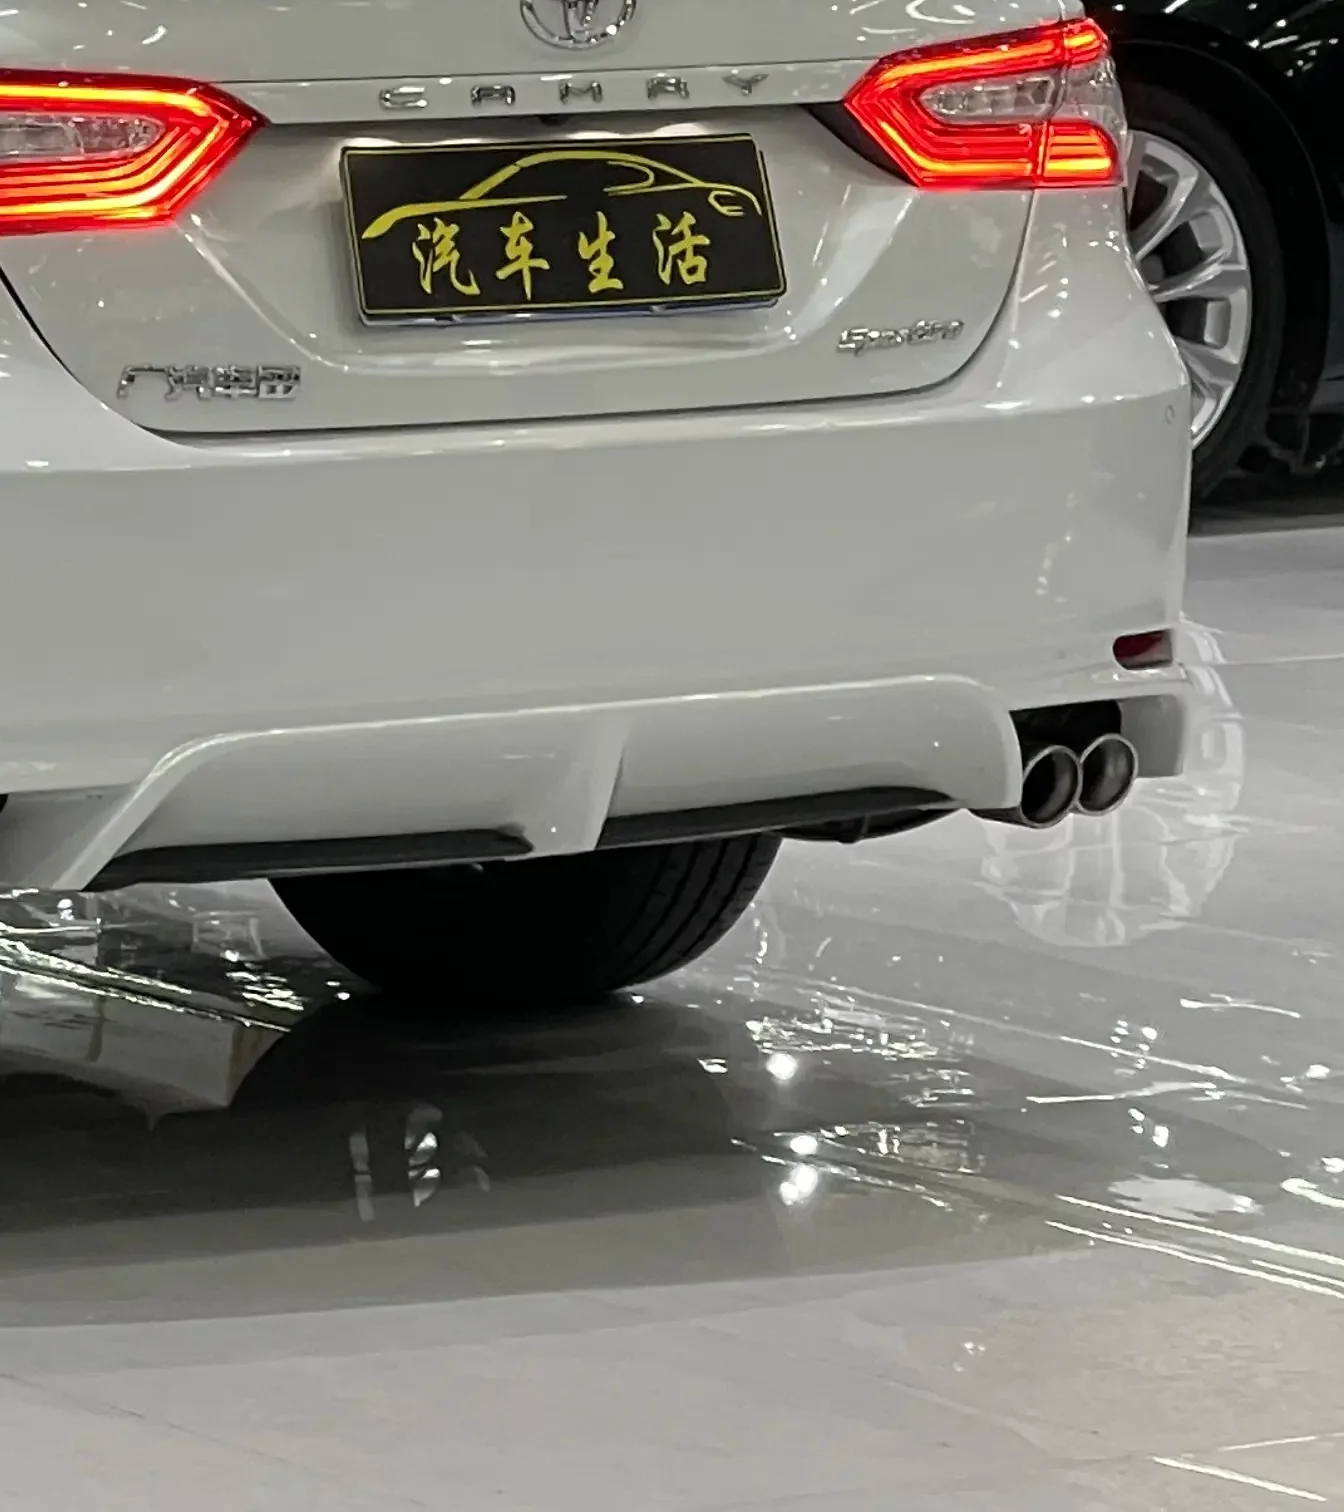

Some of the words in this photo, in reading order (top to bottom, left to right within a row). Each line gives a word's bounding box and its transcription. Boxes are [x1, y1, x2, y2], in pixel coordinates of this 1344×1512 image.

[378, 70, 769, 109] CAMRY
[412, 211, 711, 301] 汽车生活
